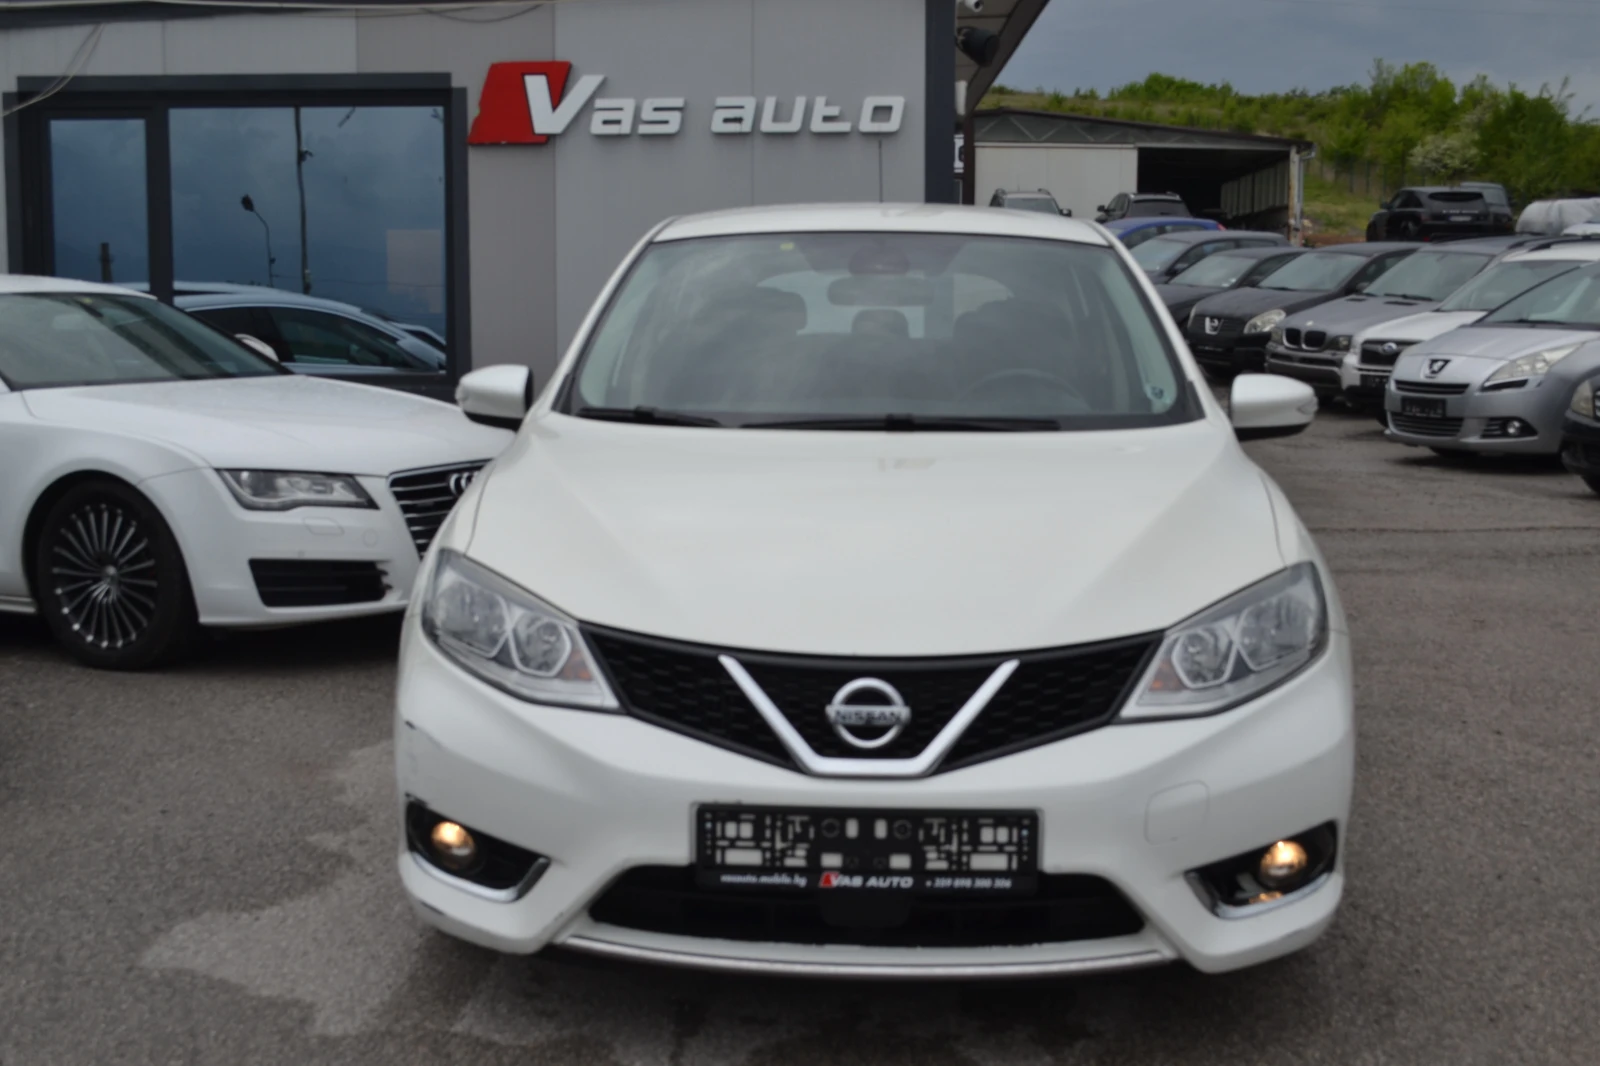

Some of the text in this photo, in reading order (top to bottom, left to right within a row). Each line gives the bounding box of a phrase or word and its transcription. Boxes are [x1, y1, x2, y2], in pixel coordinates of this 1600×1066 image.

[523, 73, 906, 136] Vas auto
[834, 709, 902, 723] NISSAN
[866, 875, 914, 888] AUTO
